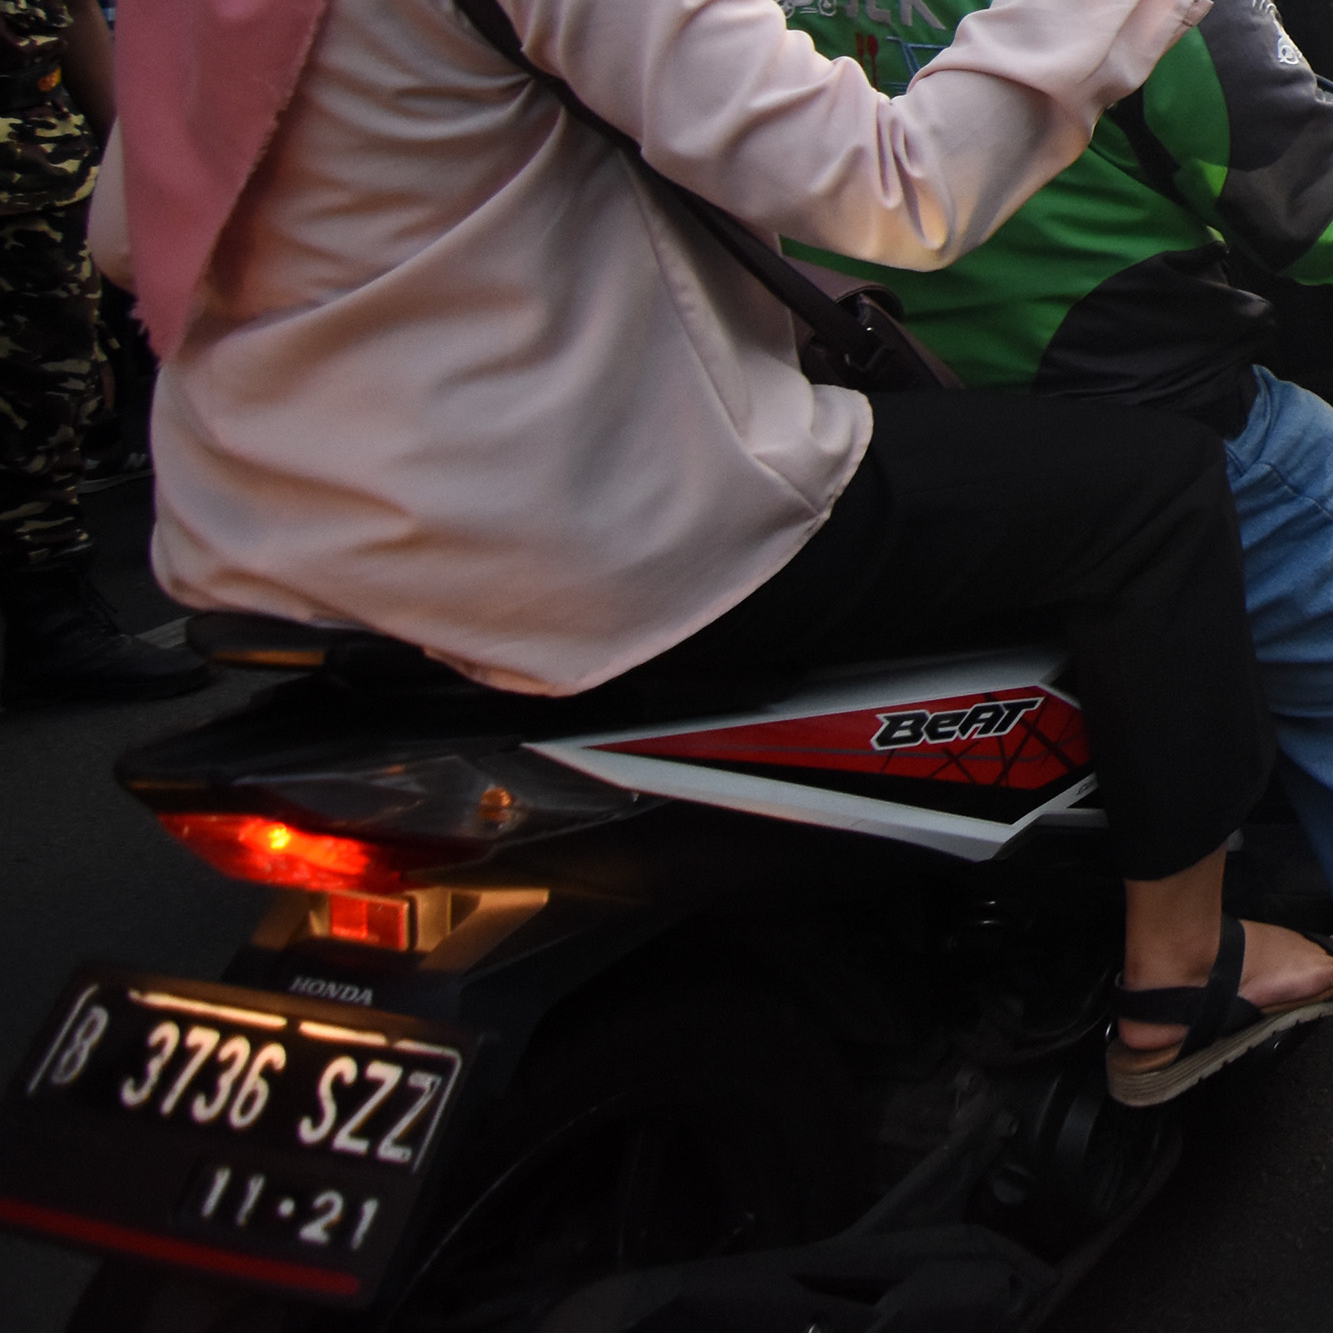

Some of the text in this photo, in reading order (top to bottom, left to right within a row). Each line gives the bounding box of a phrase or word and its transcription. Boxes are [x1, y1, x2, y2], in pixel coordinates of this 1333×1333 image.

[289, 976, 374, 1006] HONDA
[119, 1021, 288, 1130] 3736
[299, 1056, 442, 1164] SZZ
